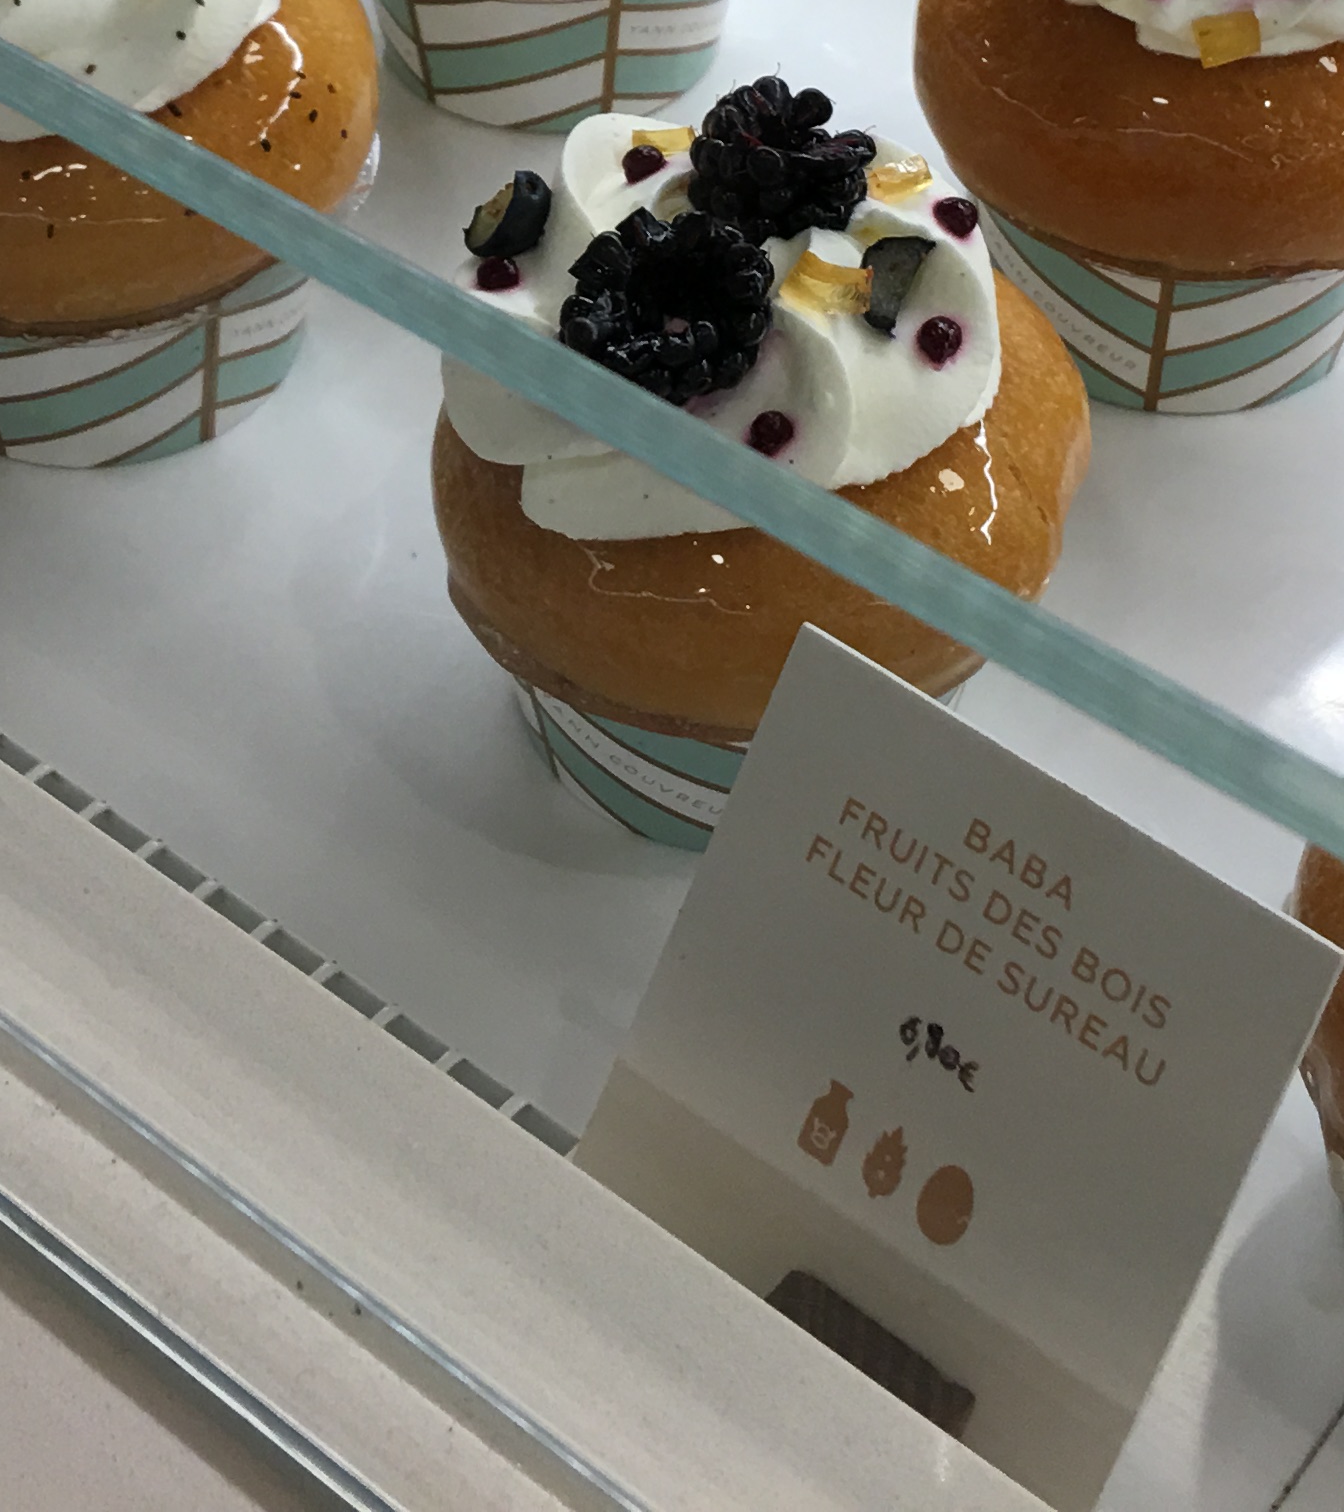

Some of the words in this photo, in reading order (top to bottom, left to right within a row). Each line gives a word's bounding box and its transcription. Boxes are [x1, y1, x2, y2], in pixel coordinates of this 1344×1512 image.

[609, 753, 723, 815] COUVREU
[964, 818, 1074, 910] BABA
[805, 835, 927, 934] FLEUR
[935, 921, 993, 975] DE
[997, 961, 1168, 1087] SUREAU
[839, 797, 976, 904] FRUITS
[982, 890, 1064, 960] DES
[1071, 947, 1173, 1030] BOIS
